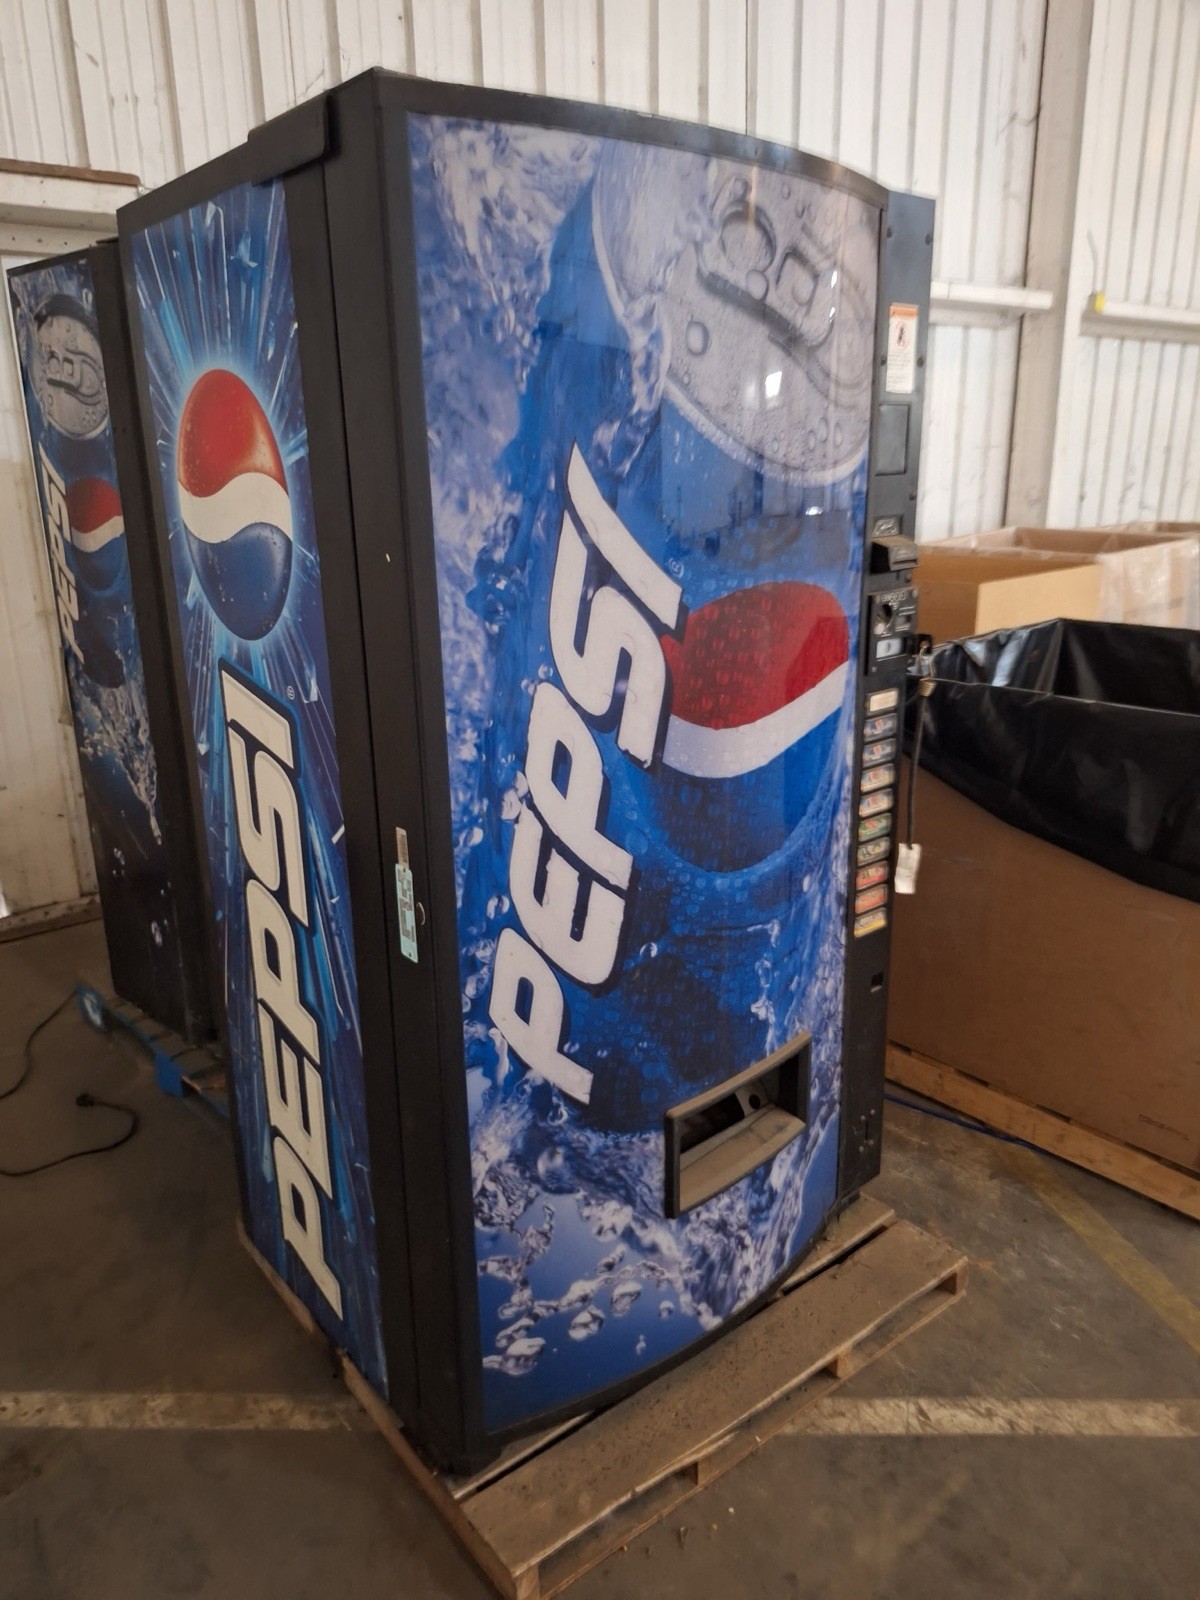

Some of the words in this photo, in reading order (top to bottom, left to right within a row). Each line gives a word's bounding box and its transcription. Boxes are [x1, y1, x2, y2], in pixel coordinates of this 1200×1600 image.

[38, 442, 84, 664] PEPSI
[488, 442, 683, 1105] PEPSI
[221, 669, 344, 1322] PEPSI
